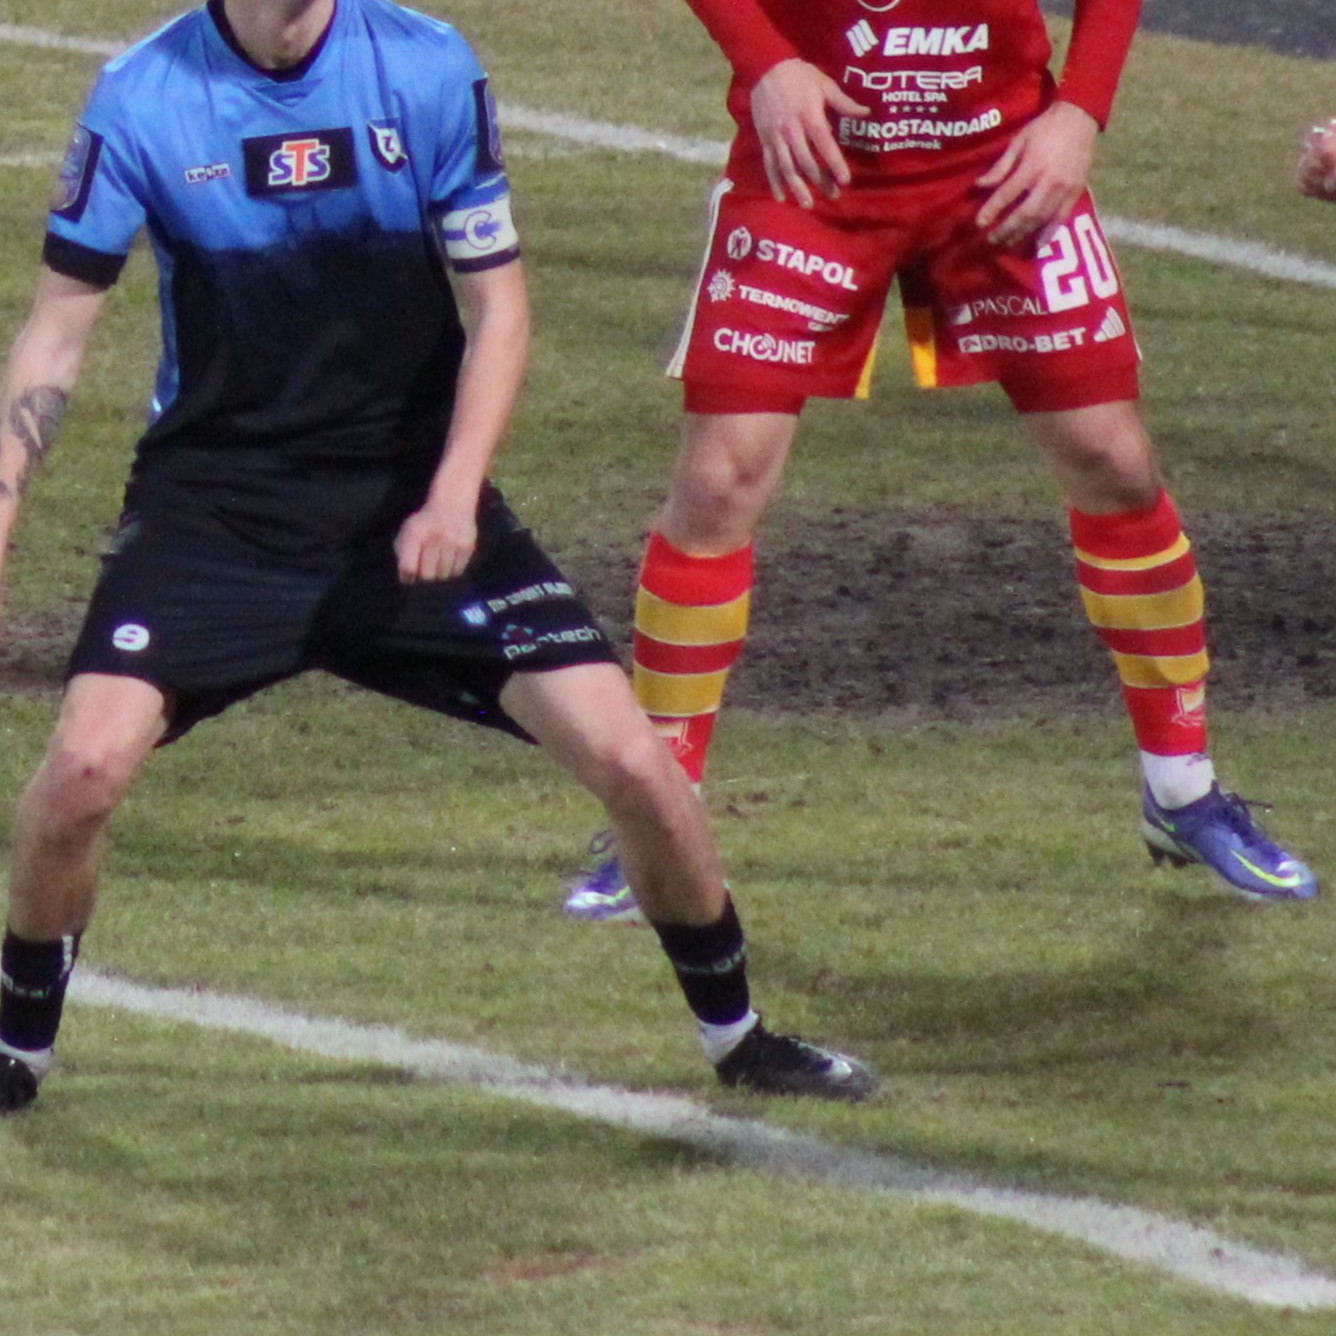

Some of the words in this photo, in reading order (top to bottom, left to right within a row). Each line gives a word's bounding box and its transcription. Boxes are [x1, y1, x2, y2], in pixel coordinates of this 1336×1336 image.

[883, 23, 989, 57] EMKA
[843, 65, 983, 90] NOTERA
[882, 91, 922, 102] HOTEL
[924, 91, 947, 102] SPA
[839, 108, 1002, 139] EUROSTANDARD
[268, 138, 330, 186] STS
[756, 239, 858, 291] STAPOL
[1037, 213, 1118, 313] 20
[972, 295, 1047, 316] PASCAL
